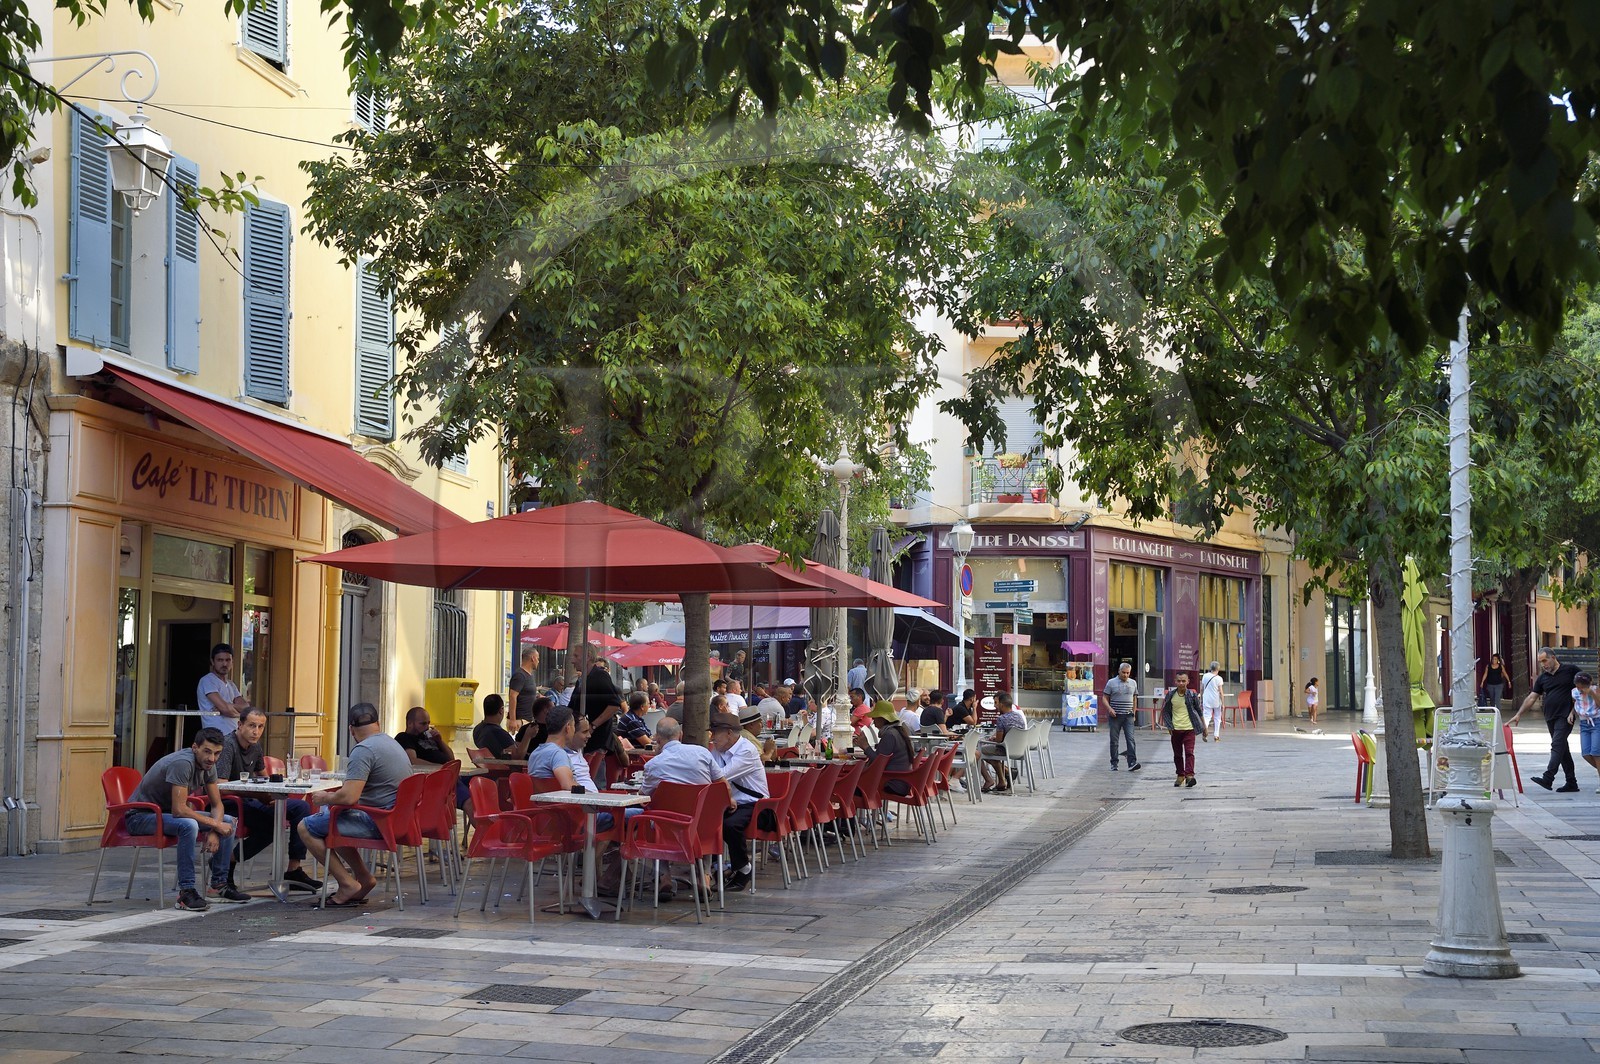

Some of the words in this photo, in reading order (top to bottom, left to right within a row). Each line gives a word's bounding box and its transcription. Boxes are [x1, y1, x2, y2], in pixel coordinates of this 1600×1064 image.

[131, 452, 184, 499] Café
[1008, 533, 1080, 547] PANISSE
[1112, 536, 1175, 559] BOULANGERIE
[1200, 550, 1249, 570] PATISSERIE
